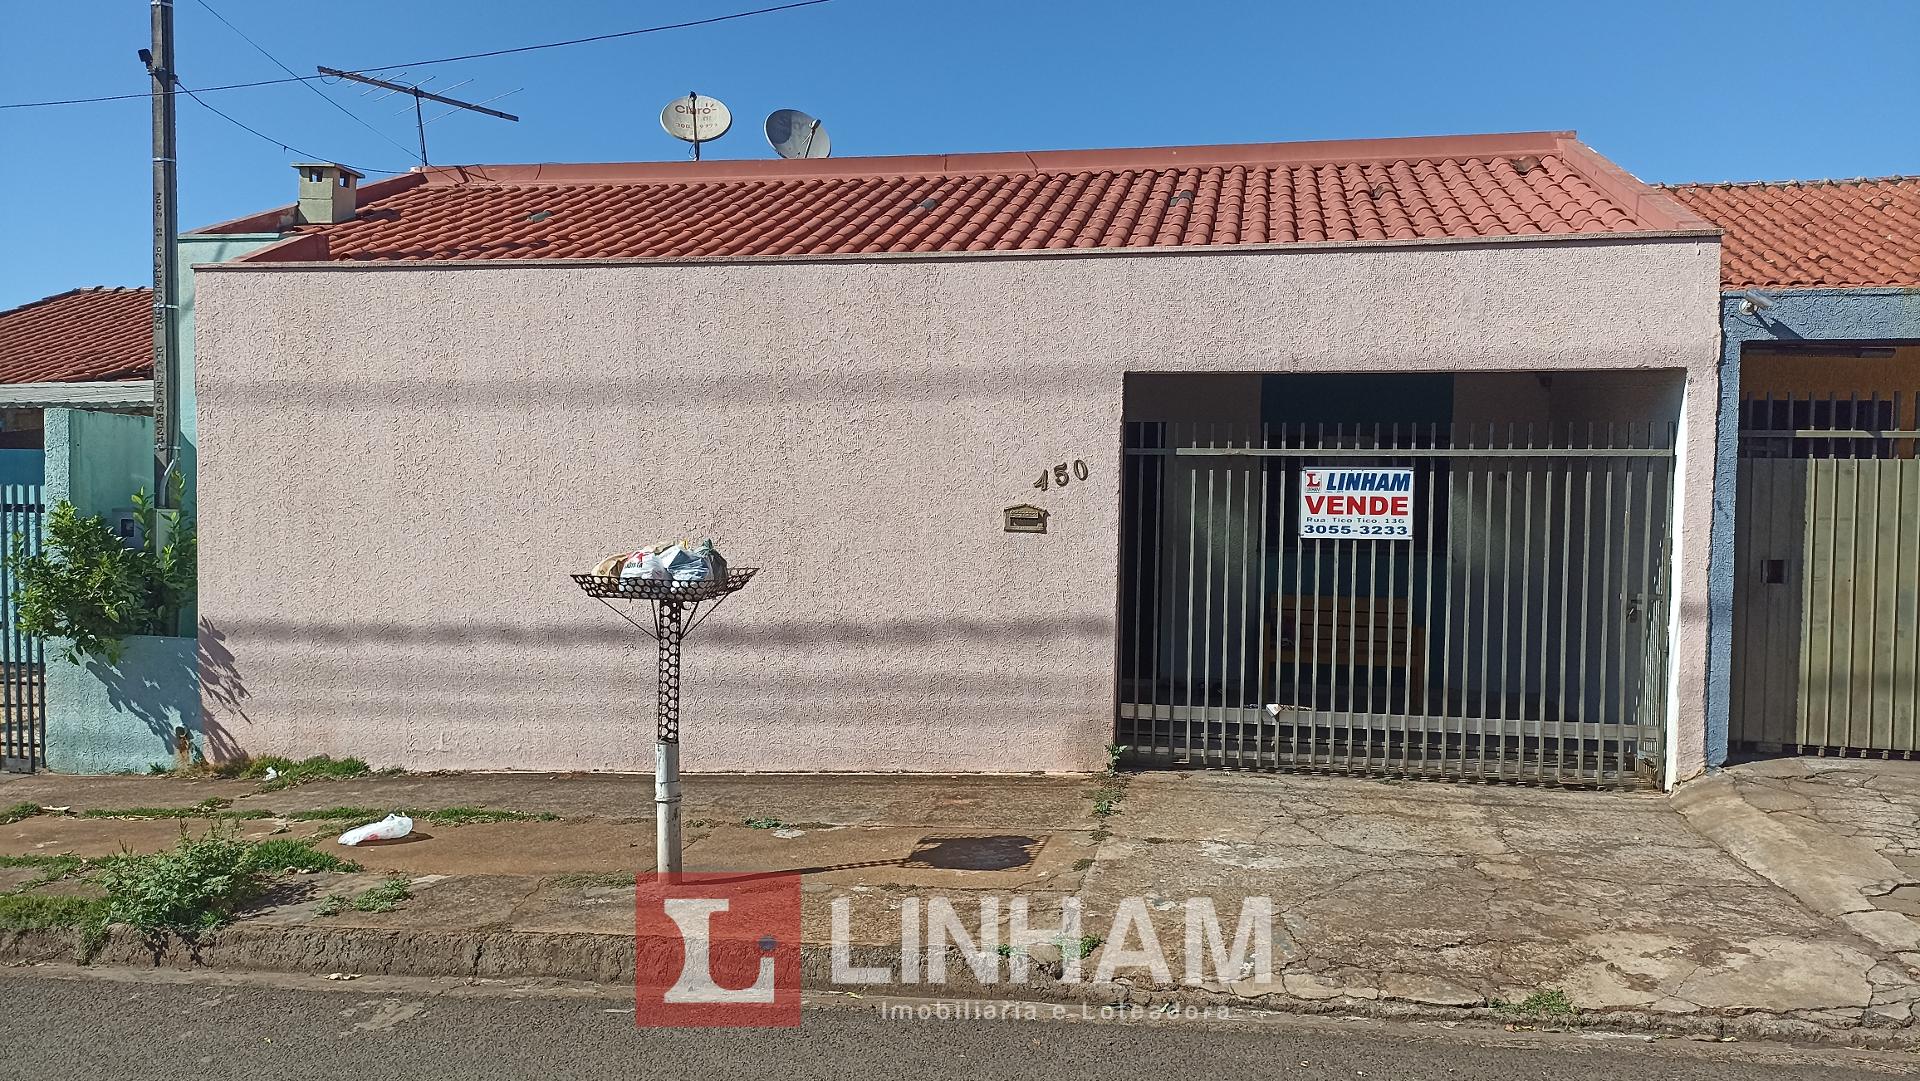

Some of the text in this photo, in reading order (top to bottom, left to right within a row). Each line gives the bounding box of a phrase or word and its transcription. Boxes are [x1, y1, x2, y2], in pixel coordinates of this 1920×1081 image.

[1326, 472, 1411, 492] LINHAM
[1305, 495, 1409, 516] VENDE
[1304, 525, 1408, 535] 3055-3233
